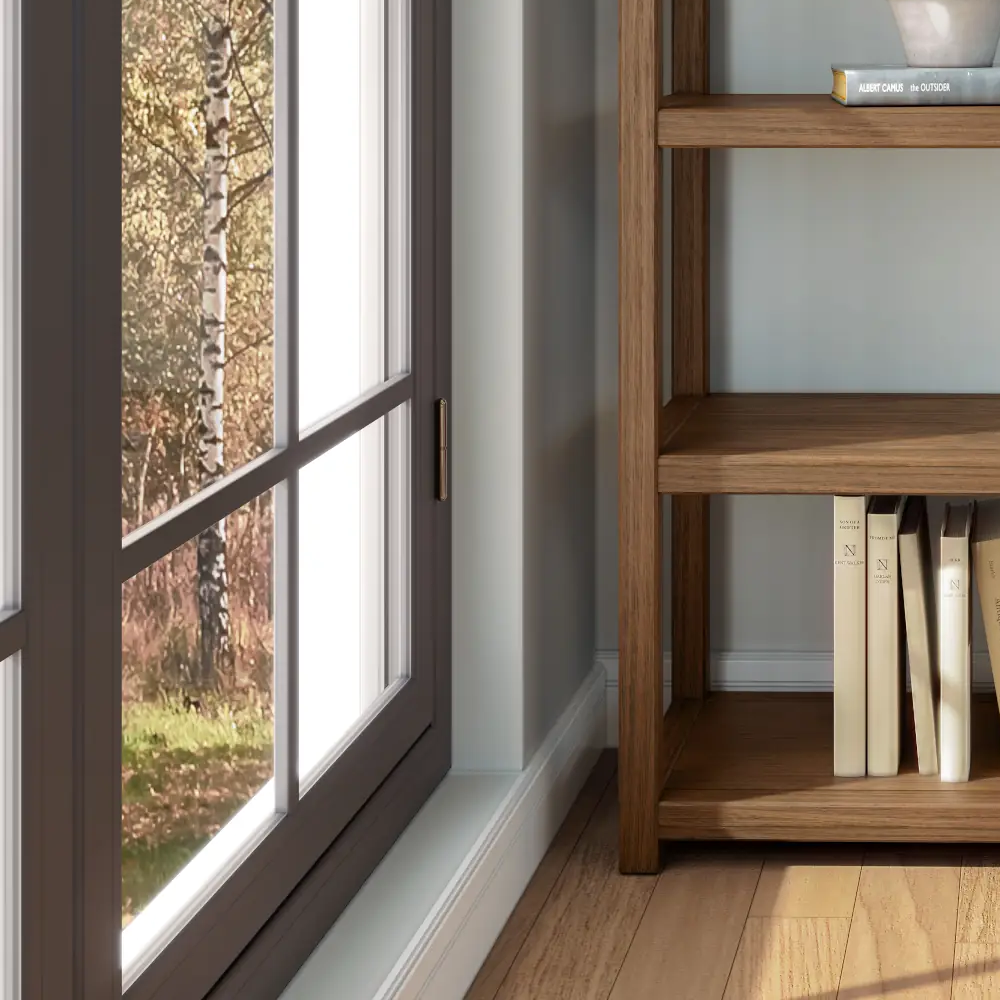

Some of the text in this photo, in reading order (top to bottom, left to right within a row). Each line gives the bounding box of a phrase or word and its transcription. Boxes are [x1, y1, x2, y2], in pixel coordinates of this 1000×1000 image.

[859, 83, 904, 92] ALBERT CAMUS
[910, 83, 951, 92] the OUTSIDER
